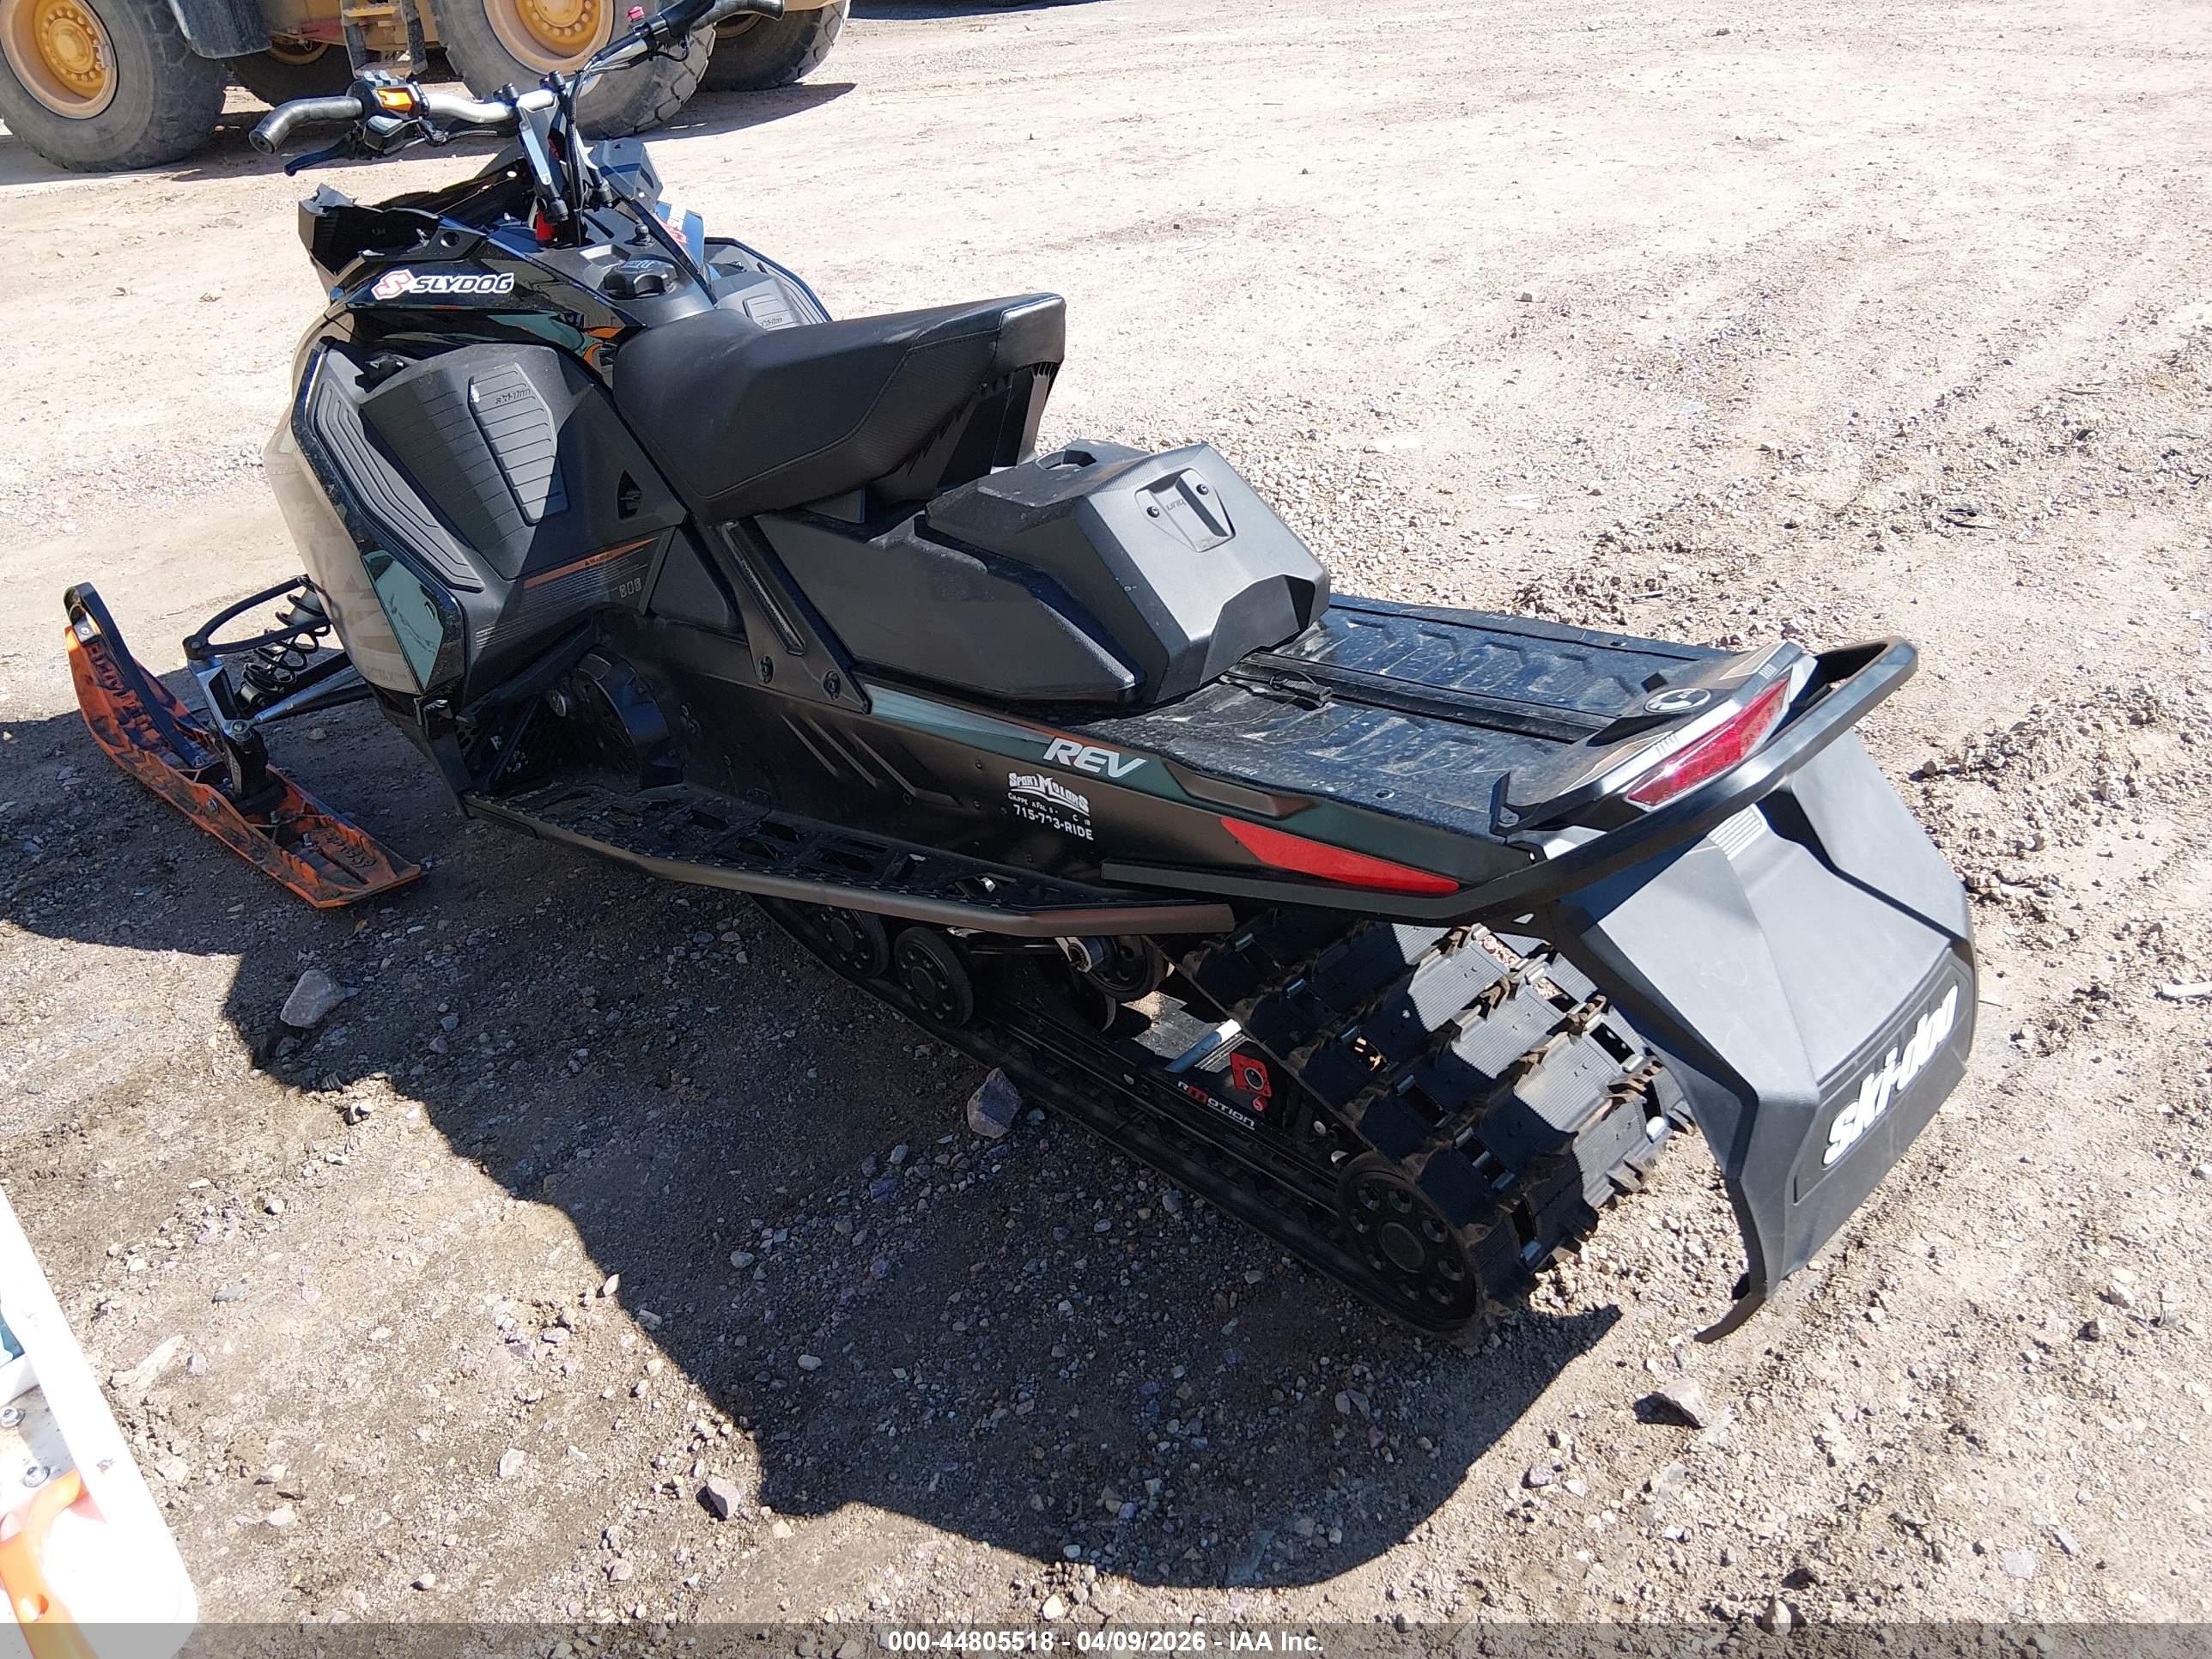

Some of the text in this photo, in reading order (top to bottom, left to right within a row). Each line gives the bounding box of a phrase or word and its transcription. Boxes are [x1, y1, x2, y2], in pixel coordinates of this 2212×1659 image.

[410, 273, 514, 293] SLYDOG
[1043, 738, 1148, 778] REV
[1823, 984, 1958, 1165] ski-doo
